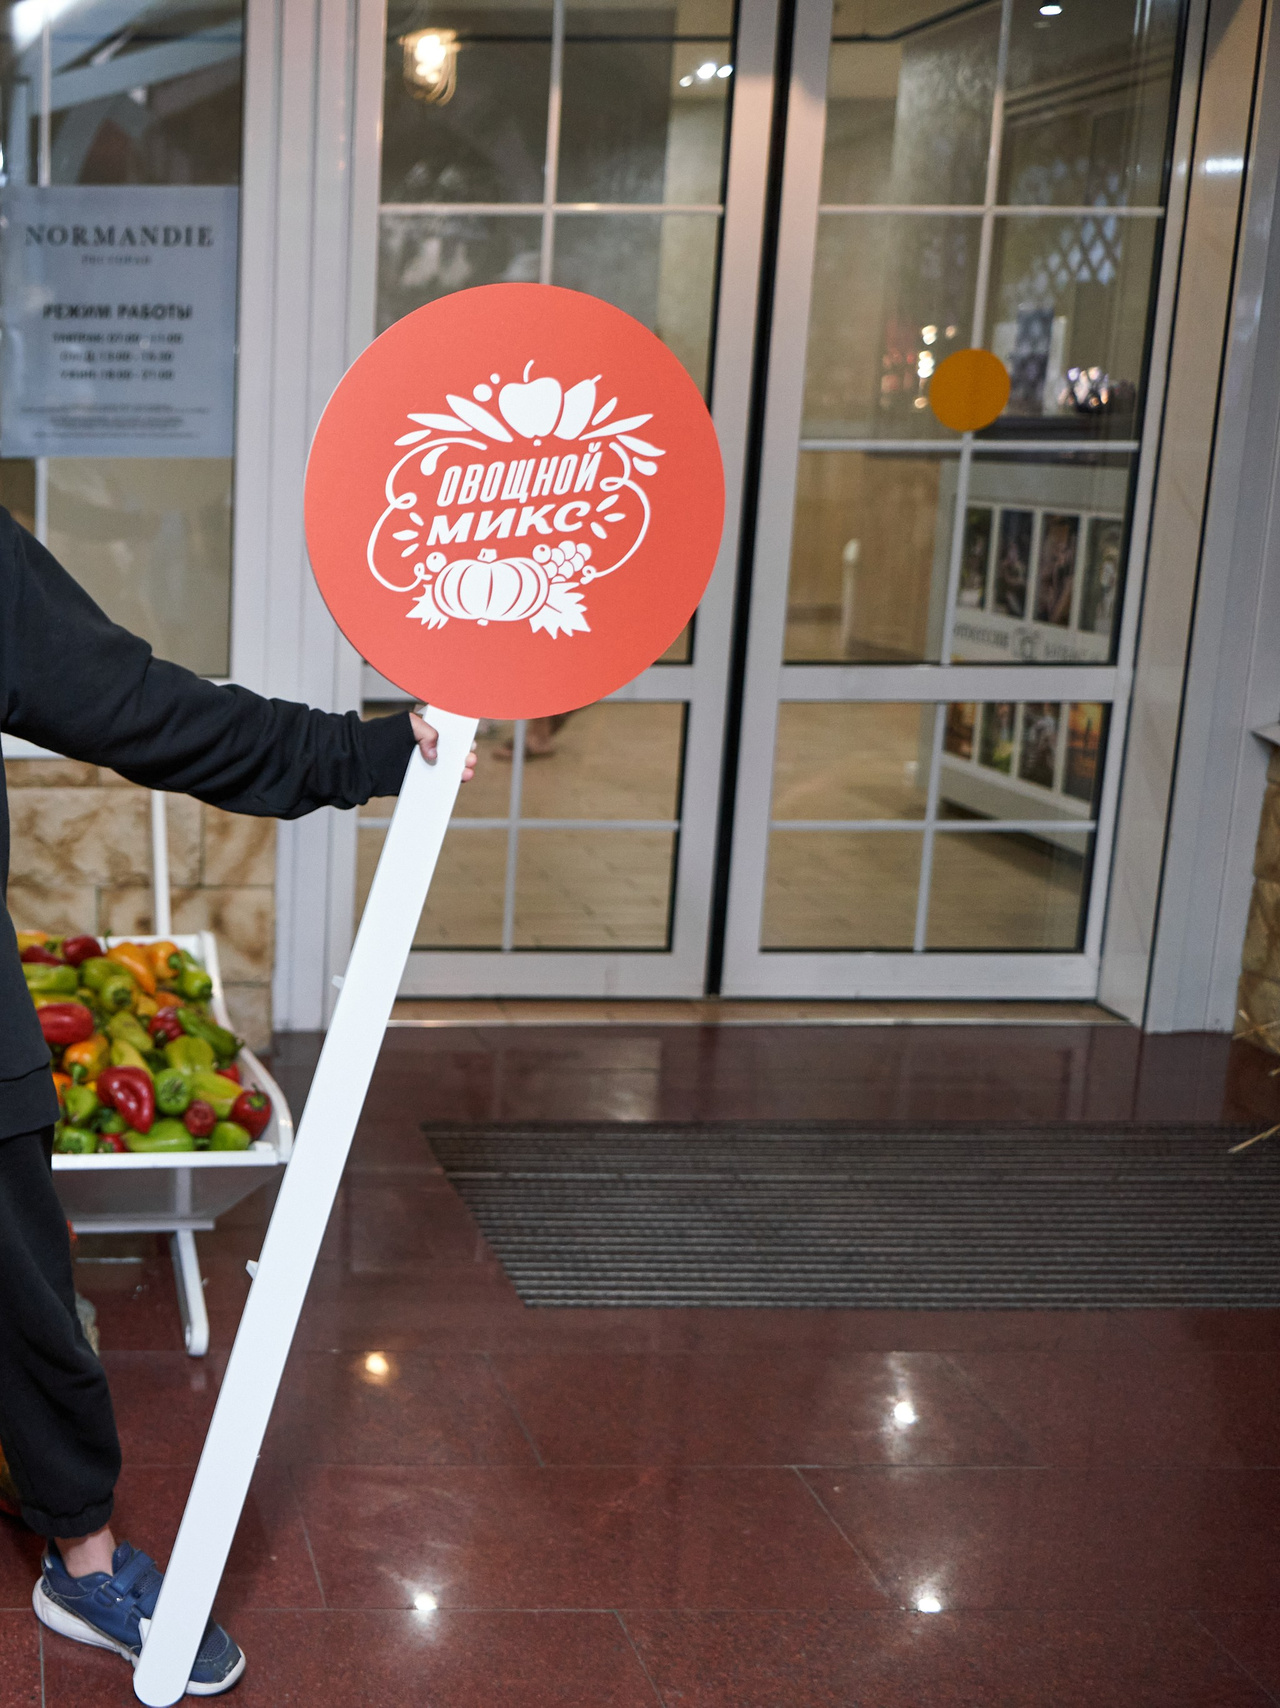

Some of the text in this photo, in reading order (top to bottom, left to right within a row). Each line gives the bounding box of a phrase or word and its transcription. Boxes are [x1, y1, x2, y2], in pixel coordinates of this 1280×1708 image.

[24, 225, 214, 247] NORMANDIE
[43, 303, 193, 320] РЕЖИМ РАБОТЫ
[436, 441, 603, 507] ОВОЩНОЙ
[426, 500, 591, 546] МИКС
